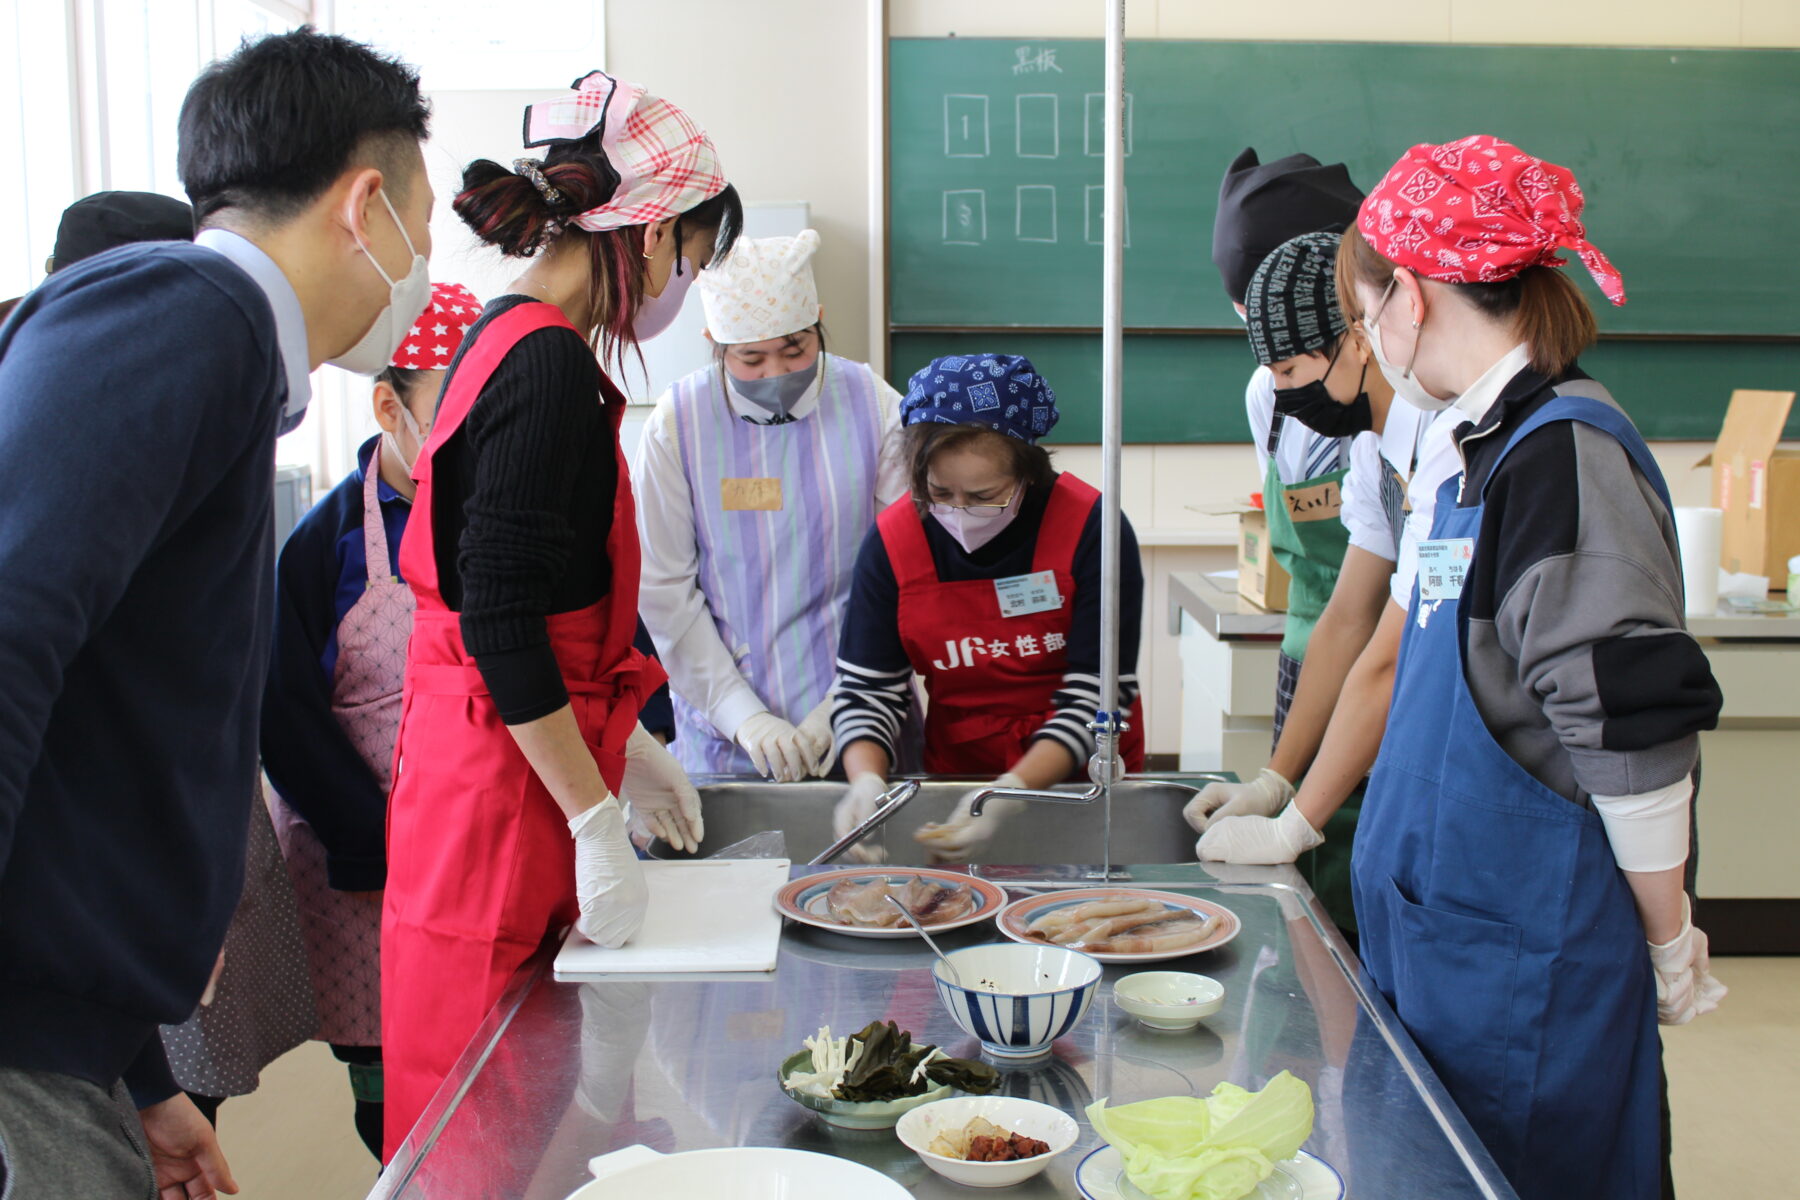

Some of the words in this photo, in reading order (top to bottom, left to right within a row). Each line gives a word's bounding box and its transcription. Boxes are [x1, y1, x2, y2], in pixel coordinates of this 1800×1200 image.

[1012, 46, 1063, 75] 黒板
[961, 115, 969, 140] 1
[1267, 295, 1288, 329] EASY
